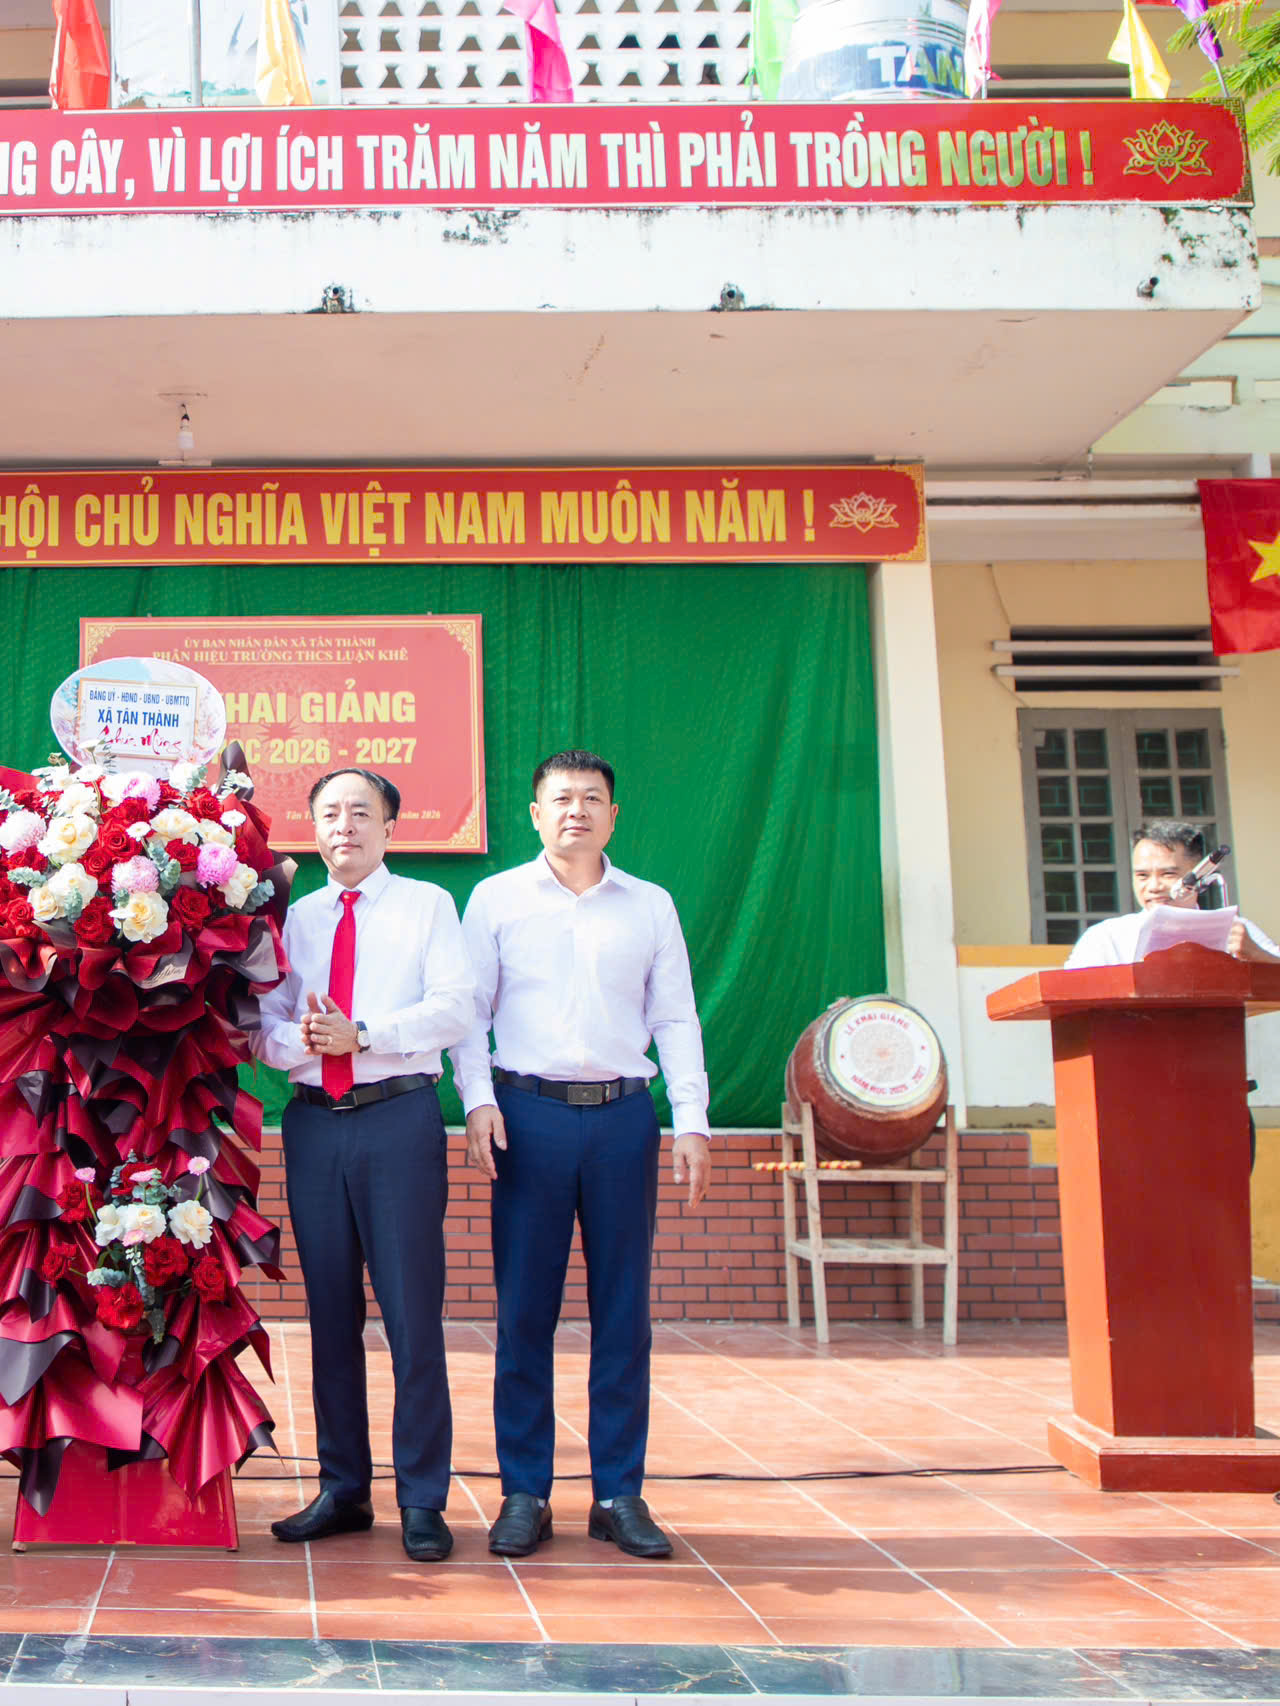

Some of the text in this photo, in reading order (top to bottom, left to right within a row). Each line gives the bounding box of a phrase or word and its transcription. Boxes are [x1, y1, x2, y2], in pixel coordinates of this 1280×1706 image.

[50, 127, 136, 200] CÂY,
[149, 119, 187, 193] VÌ
[199, 129, 263, 202] LỢI
[276, 123, 343, 192] ÍCH
[356, 122, 477, 191] TRĂM
[488, 121, 589, 190] NĂM
[600, 120, 667, 189] THÌ
[679, 109, 778, 188] PHẢI
[789, 111, 928, 188] TRỒNG
[938, 115, 1068, 187] NGƯỜI
[1079, 129, 1095, 186] !
[74, 475, 158, 547] CHỦ
[174, 482, 308, 547] NGHĨA
[320, 481, 411, 556] VIỆT
[424, 491, 524, 545] NAM
[540, 478, 673, 544] MUÔN
[686, 478, 787, 543] NĂM
[802, 490, 816, 541] !
[203, 638, 226, 649] BAN
[229, 636, 261, 649] NHÂN
[263, 636, 288, 648] DÂN
[291, 635, 307, 648] XÃ
[309, 635, 333, 648] TÂN
[335, 635, 376, 648] THÀNH
[193, 649, 229, 665] HIỆU
[231, 646, 293, 662] TRƯỜNG
[295, 650, 334, 662] THCS
[336, 648, 375, 664] LUẬN
[378, 646, 409, 662] KHÊ
[143, 693, 161, 705] UBND
[222, 678, 417, 724] HAI GIẢNG
[97, 707, 180, 728] XÃ TÂN THÀNH
[270, 737, 331, 765] 2026
[355, 737, 418, 764] 2027
